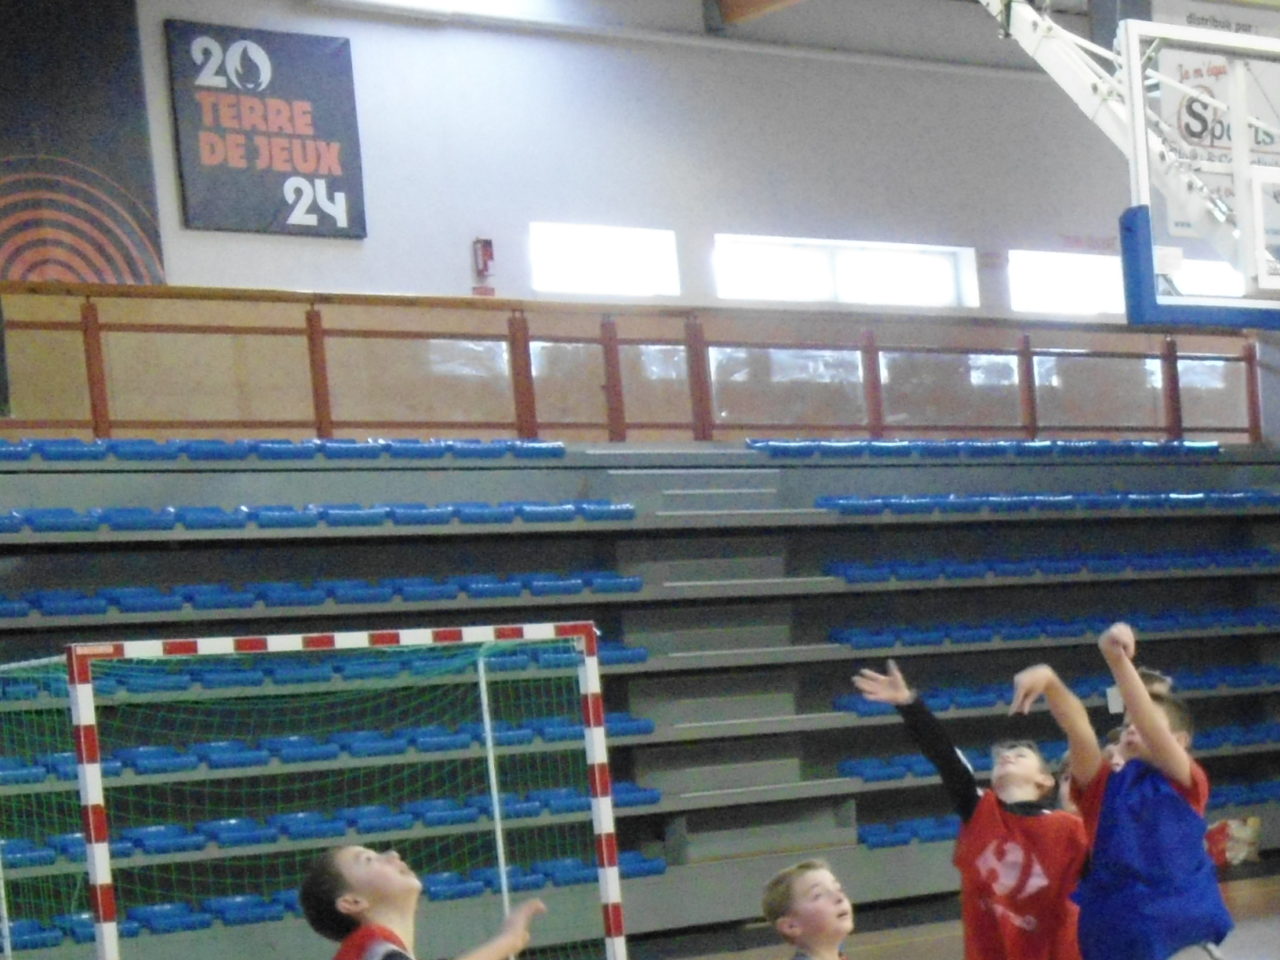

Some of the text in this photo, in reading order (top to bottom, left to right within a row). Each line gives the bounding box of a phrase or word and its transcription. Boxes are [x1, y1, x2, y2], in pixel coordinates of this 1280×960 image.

[190, 36, 272, 91] 20
[195, 90, 314, 135] TERRE
[1184, 97, 1274, 147] Spts
[198, 131, 342, 175] DE JEUX
[283, 176, 348, 228] 24
